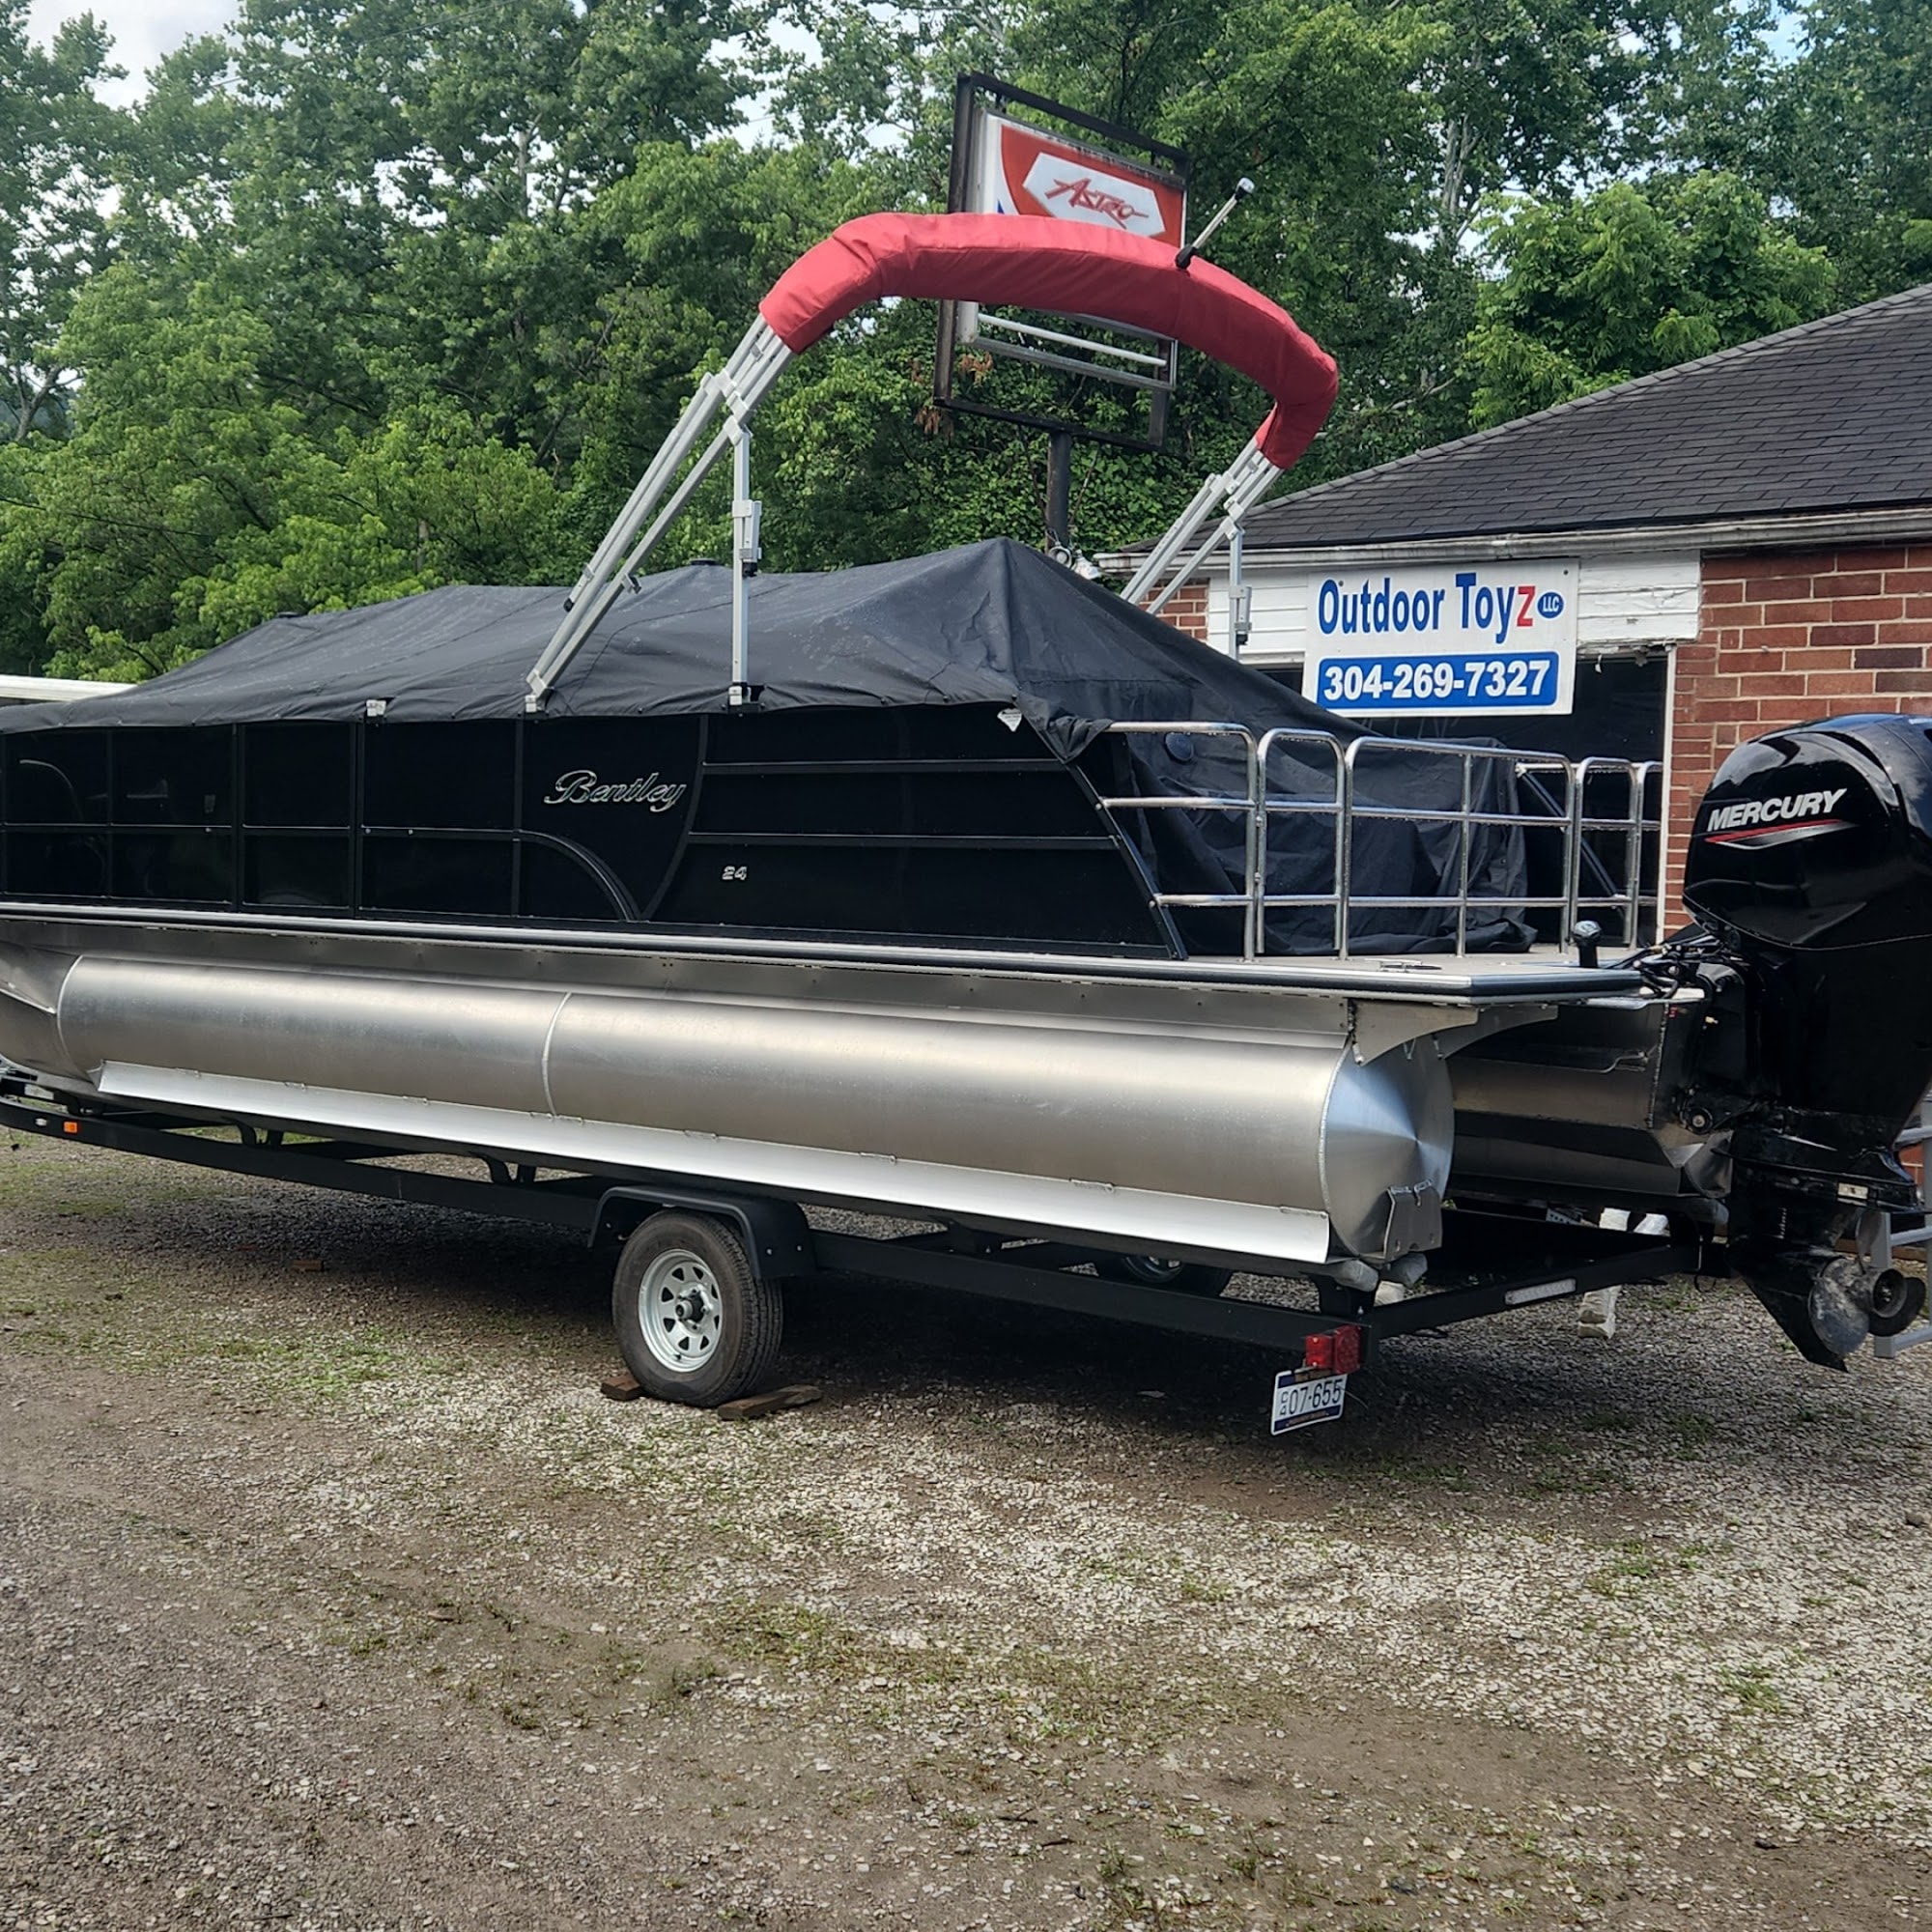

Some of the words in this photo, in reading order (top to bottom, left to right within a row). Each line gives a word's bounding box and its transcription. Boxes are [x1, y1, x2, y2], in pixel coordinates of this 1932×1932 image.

[1318, 577, 1446, 635] Outdoor
[1542, 595, 1560, 612] LLC
[1323, 659, 1550, 701] 304-269-7327
[544, 769, 687, 812] Bentley
[1707, 787, 1848, 833] MERCURY
[722, 866, 748, 881] 24
